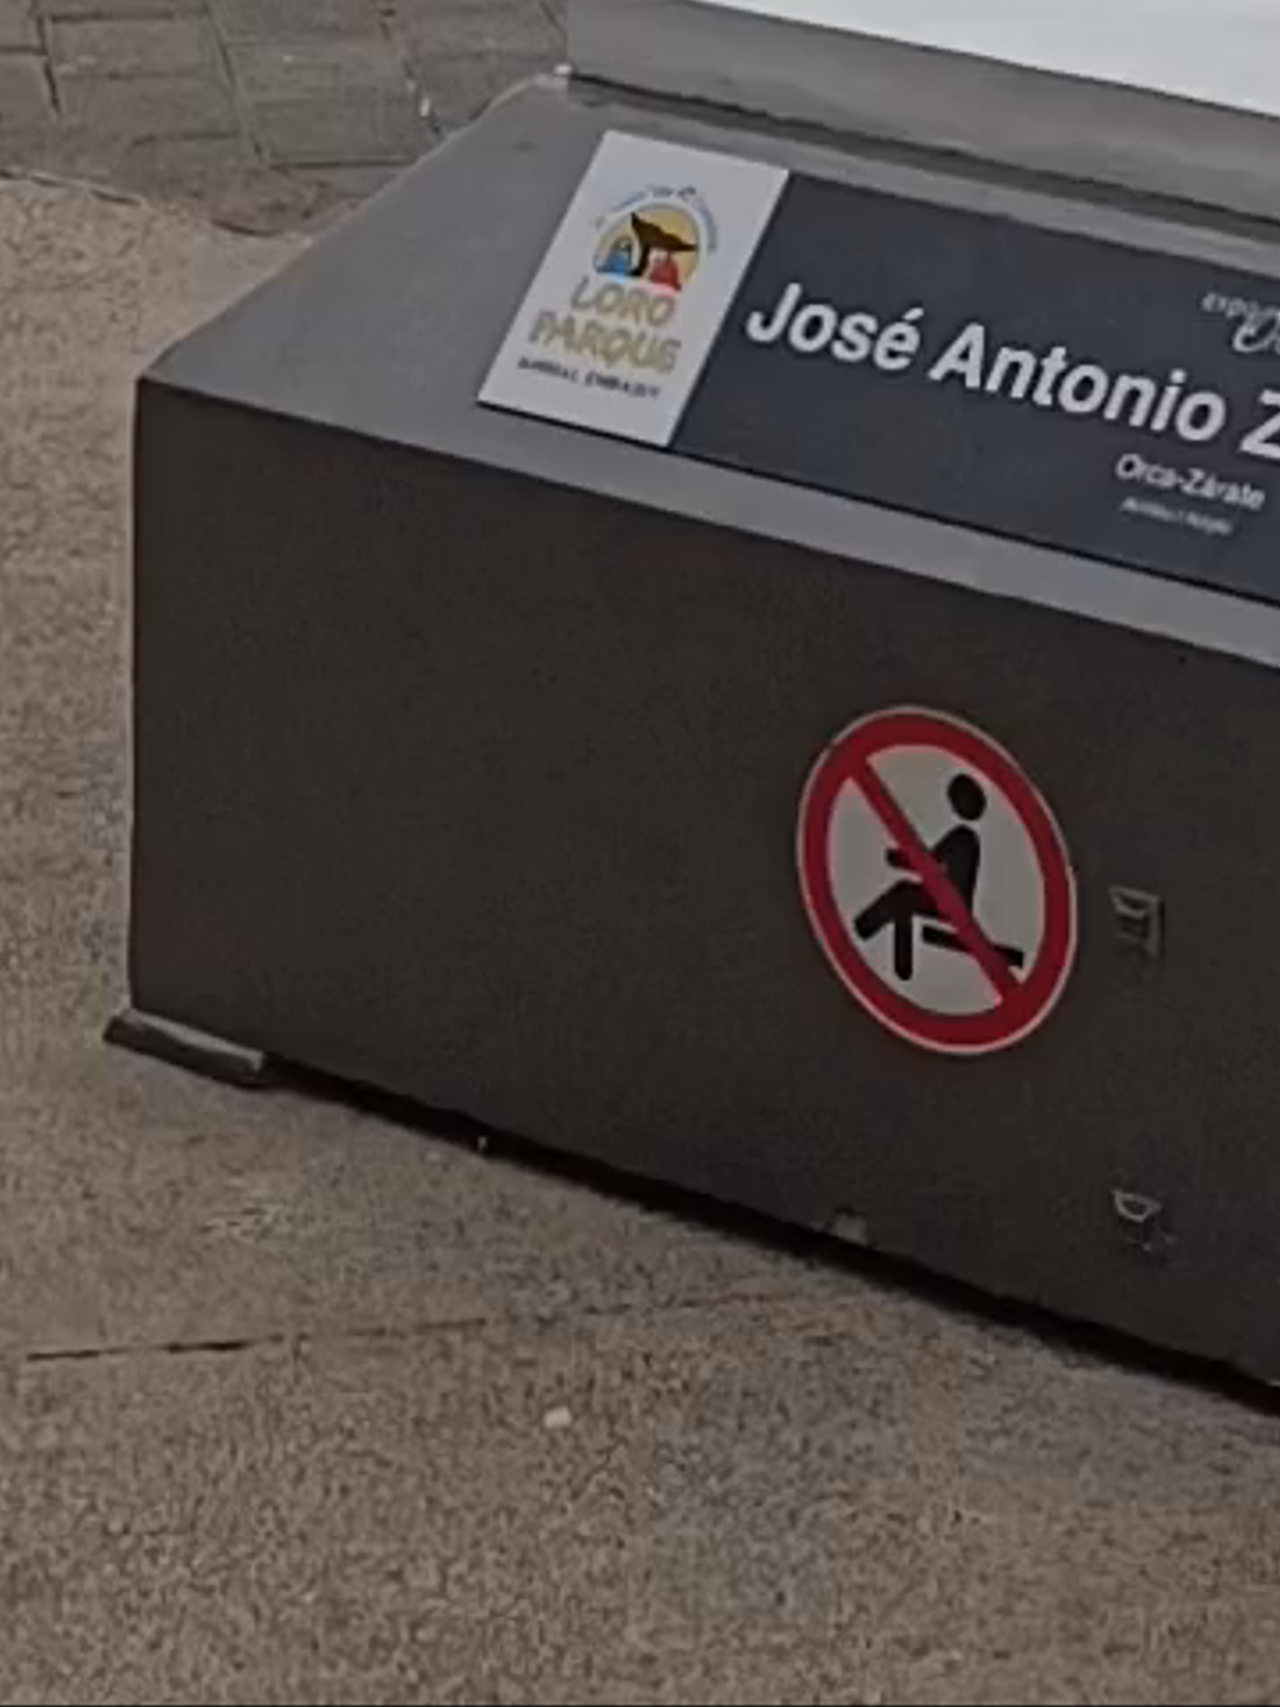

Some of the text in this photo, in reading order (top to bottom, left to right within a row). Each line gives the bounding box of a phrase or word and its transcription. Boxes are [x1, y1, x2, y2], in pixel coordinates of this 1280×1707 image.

[571, 276, 676, 328] LORO
[528, 310, 683, 375] PARQUE
[745, 282, 925, 370] José
[928, 322, 1227, 441] Antonio
